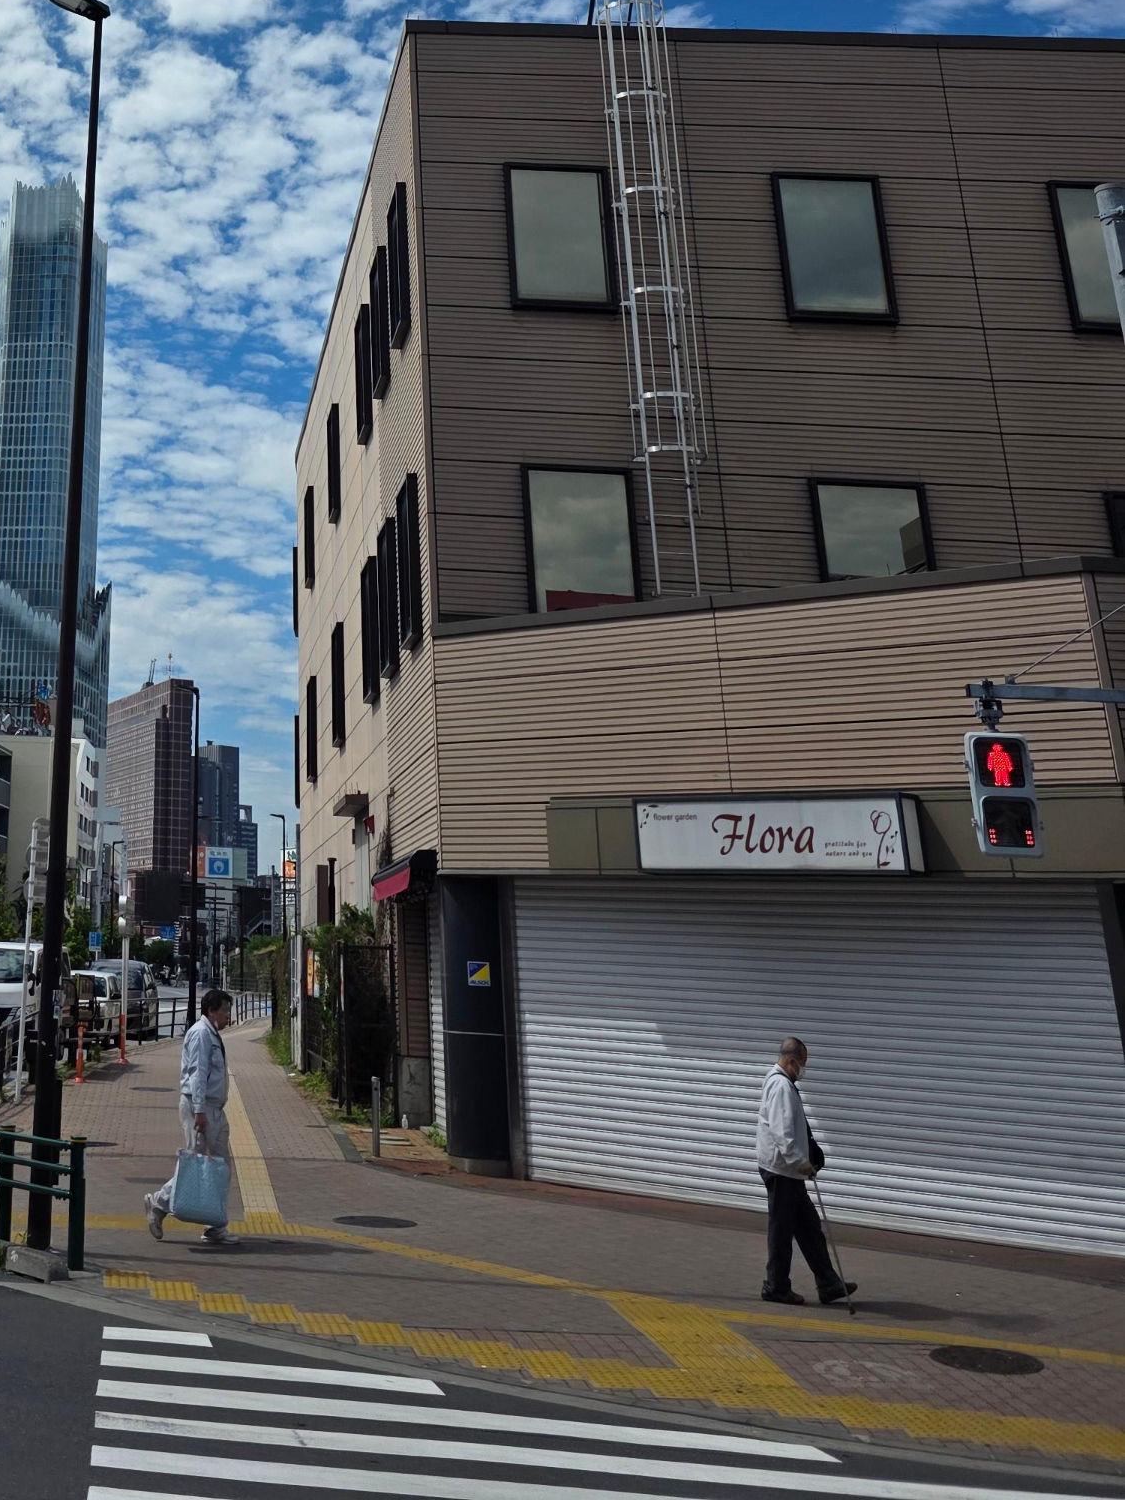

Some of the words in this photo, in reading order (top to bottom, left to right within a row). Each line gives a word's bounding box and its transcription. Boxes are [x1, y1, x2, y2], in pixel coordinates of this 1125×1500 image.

[653, 813, 674, 821] flower
[675, 813, 698, 822] garden
[711, 813, 815, 856] Flora
